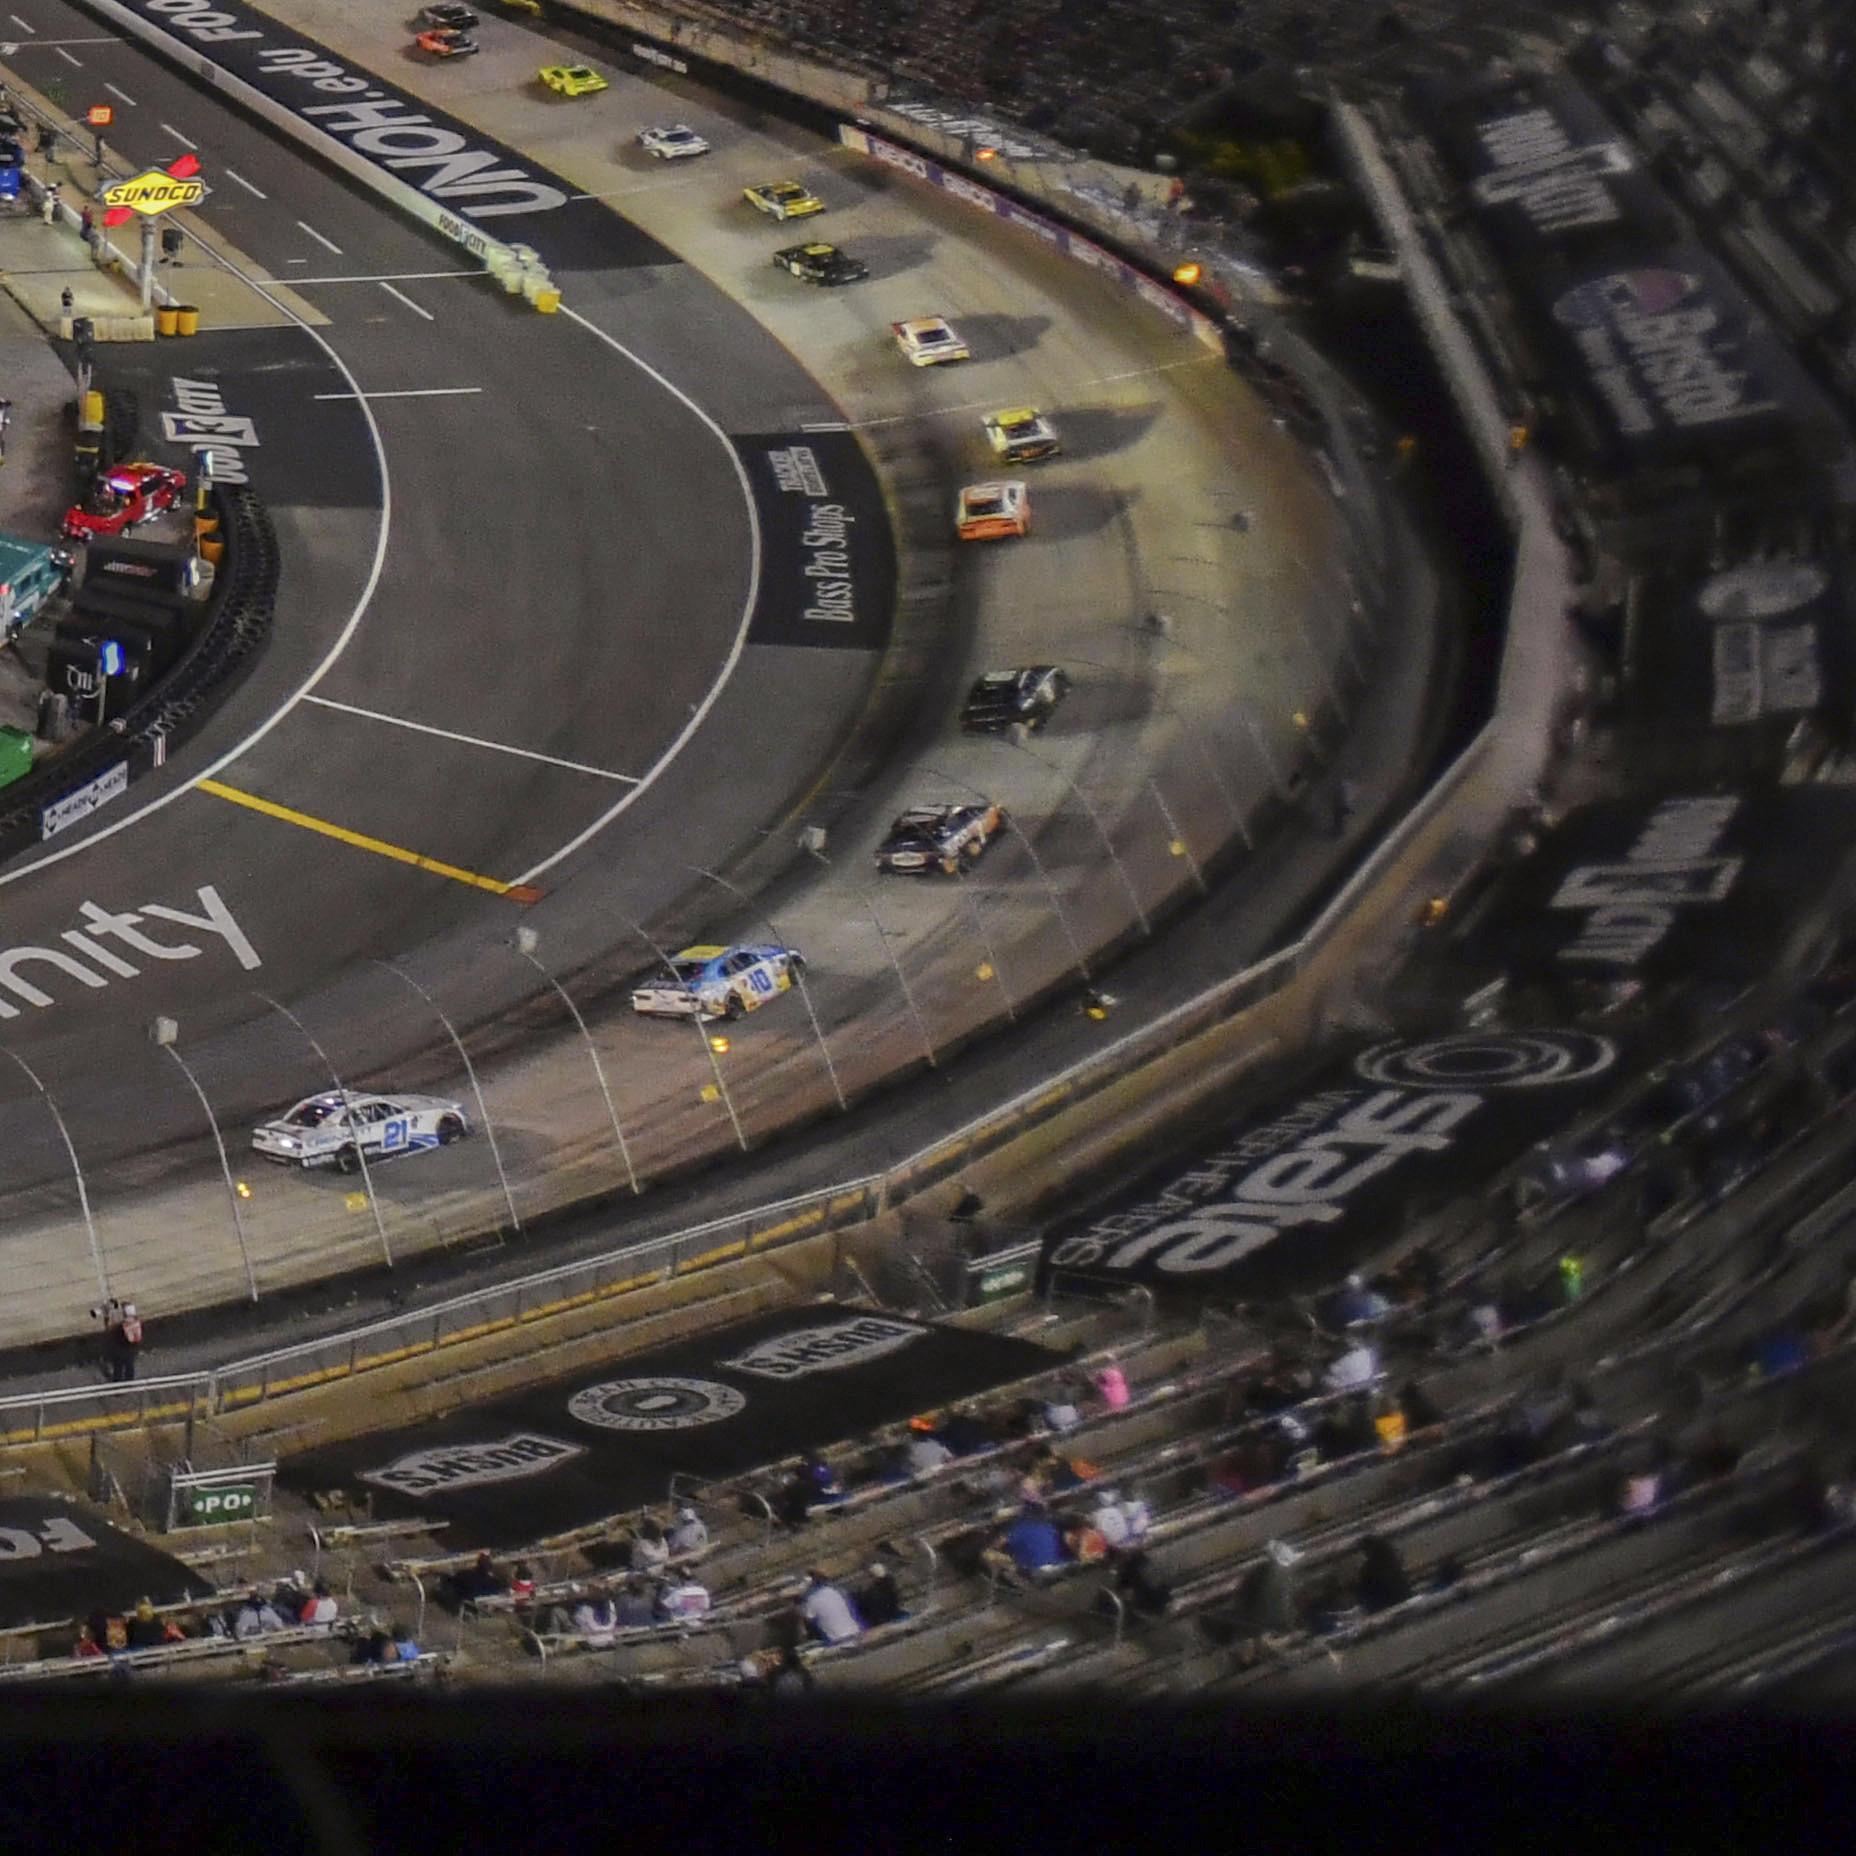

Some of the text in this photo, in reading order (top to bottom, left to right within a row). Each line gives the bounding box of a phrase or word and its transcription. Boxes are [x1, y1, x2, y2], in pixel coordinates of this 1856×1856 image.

[260, 47, 568, 216] UNOH.edu
[108, 185, 200, 204] SUNOCO
[802, 504, 856, 622] Bass Pro Shops
[749, 969, 772, 992] 10
[385, 1120, 410, 1146] 21
[750, 1318, 902, 1377] BUSH'S
[387, 1434, 564, 1493] BUSH'S
